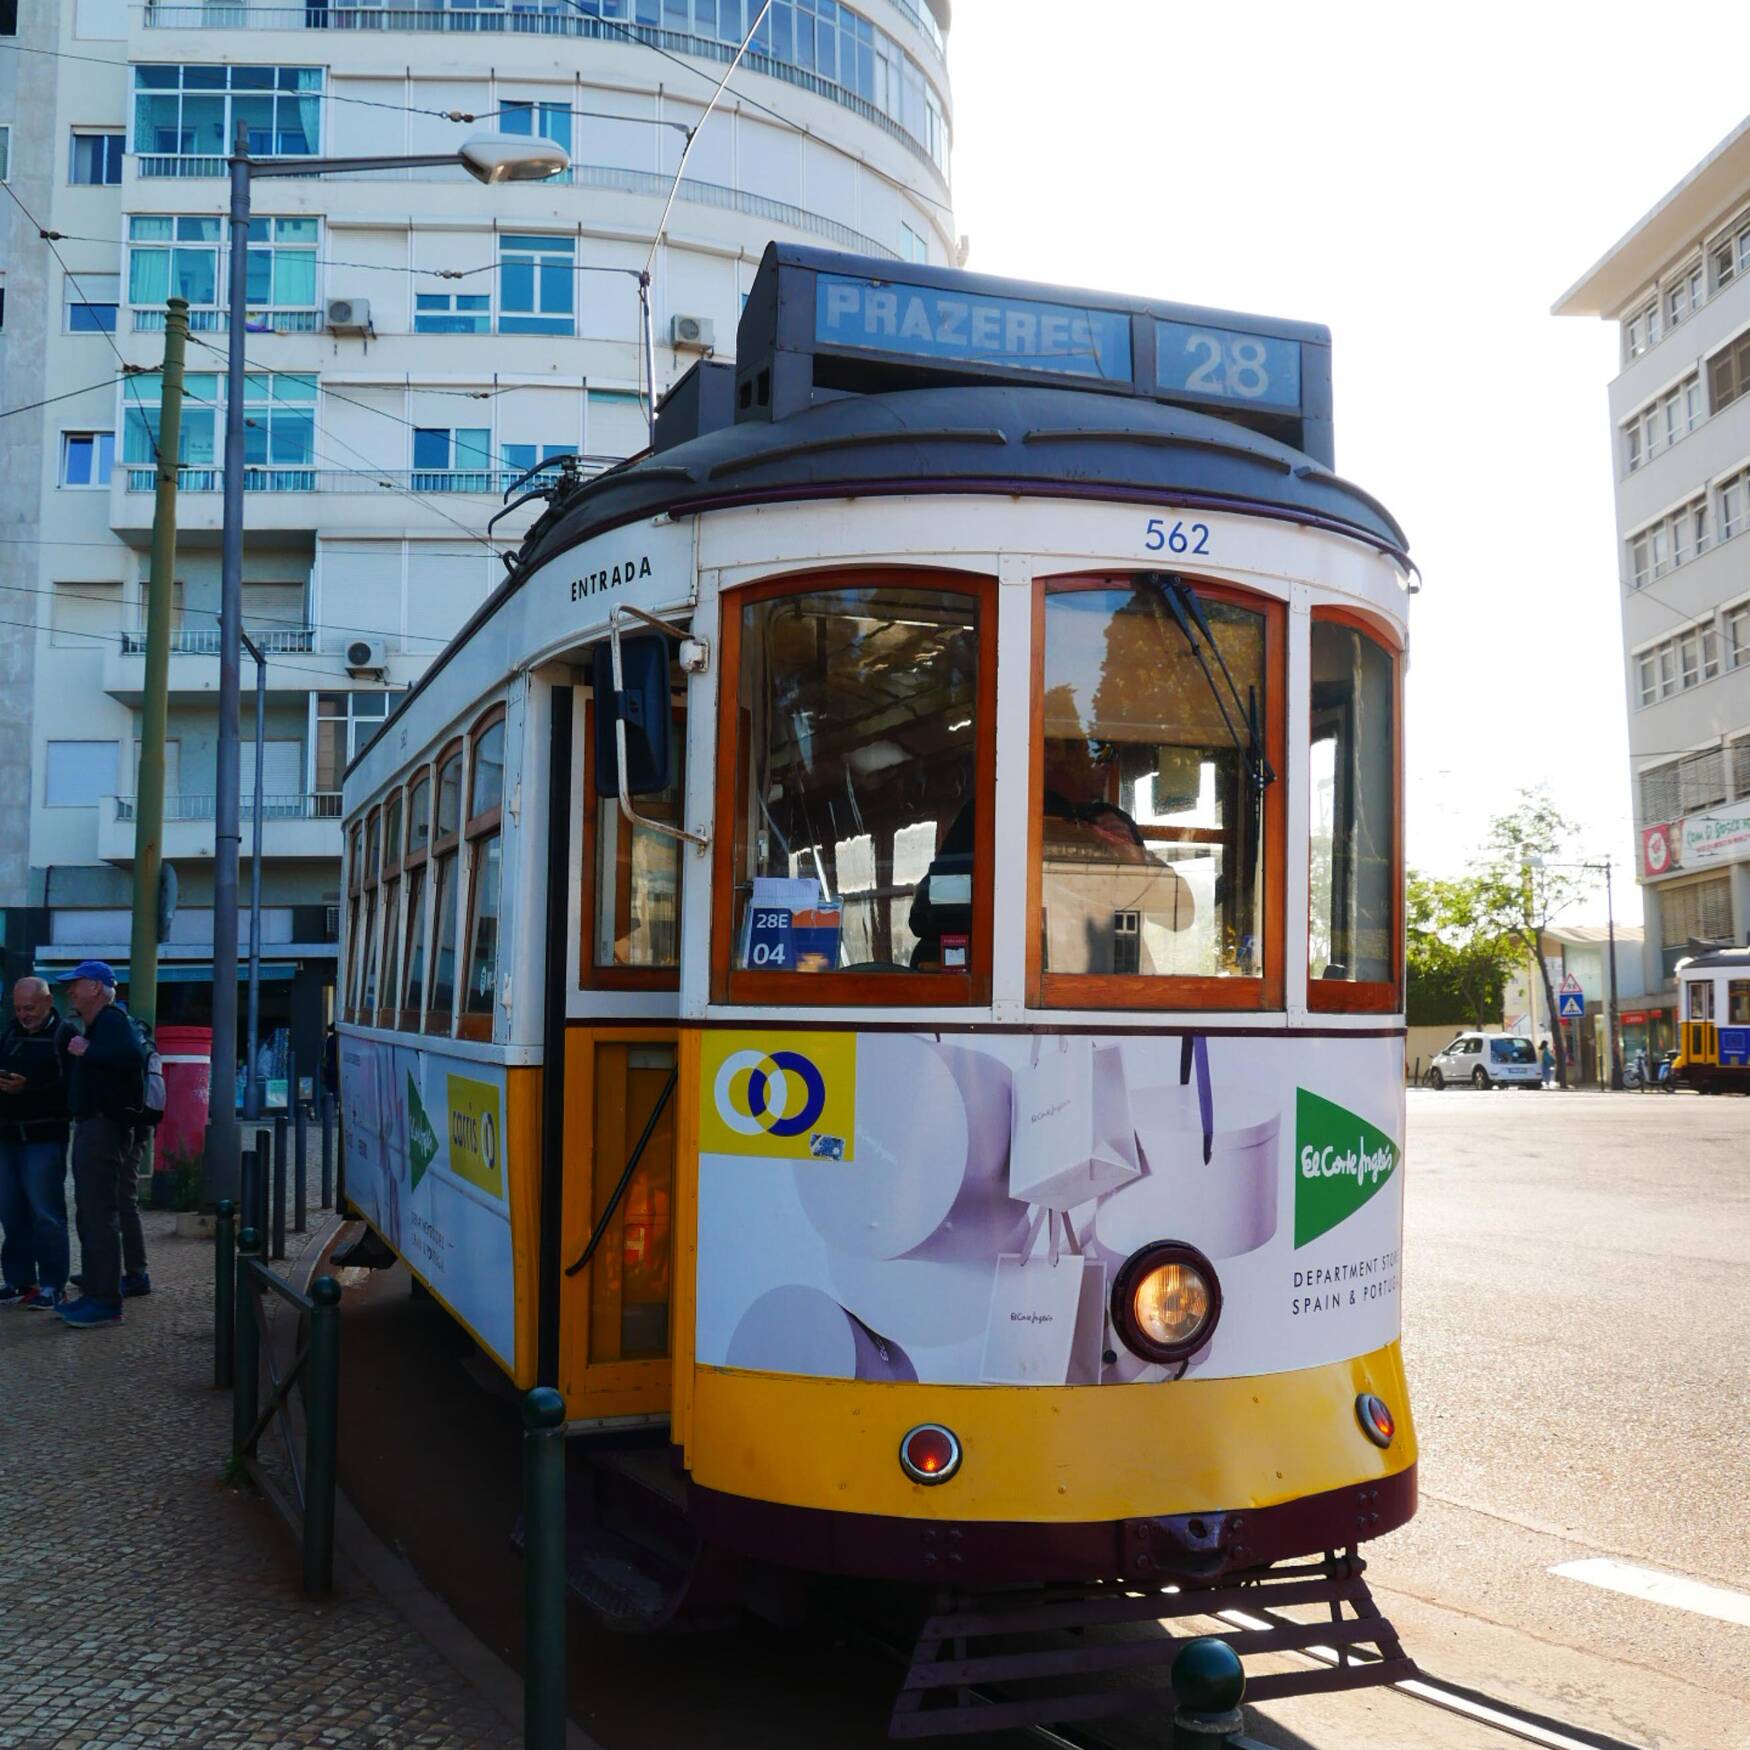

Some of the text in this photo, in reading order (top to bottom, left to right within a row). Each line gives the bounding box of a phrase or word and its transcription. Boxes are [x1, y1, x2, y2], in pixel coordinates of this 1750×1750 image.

[826, 283, 1101, 354] PRAZERES
[1184, 334, 1269, 399] 28
[1145, 519, 1211, 555] 562
[571, 556, 652, 602] ENTRADA
[756, 914, 787, 929] 28E
[753, 943, 786, 965] 04
[1301, 1135, 1392, 1186] El Corte Inglés
[1294, 1249, 1397, 1288] DEPARTMENT STO
[1292, 1292, 1341, 1315] SPAIN
[1349, 1289, 1356, 1305] &
